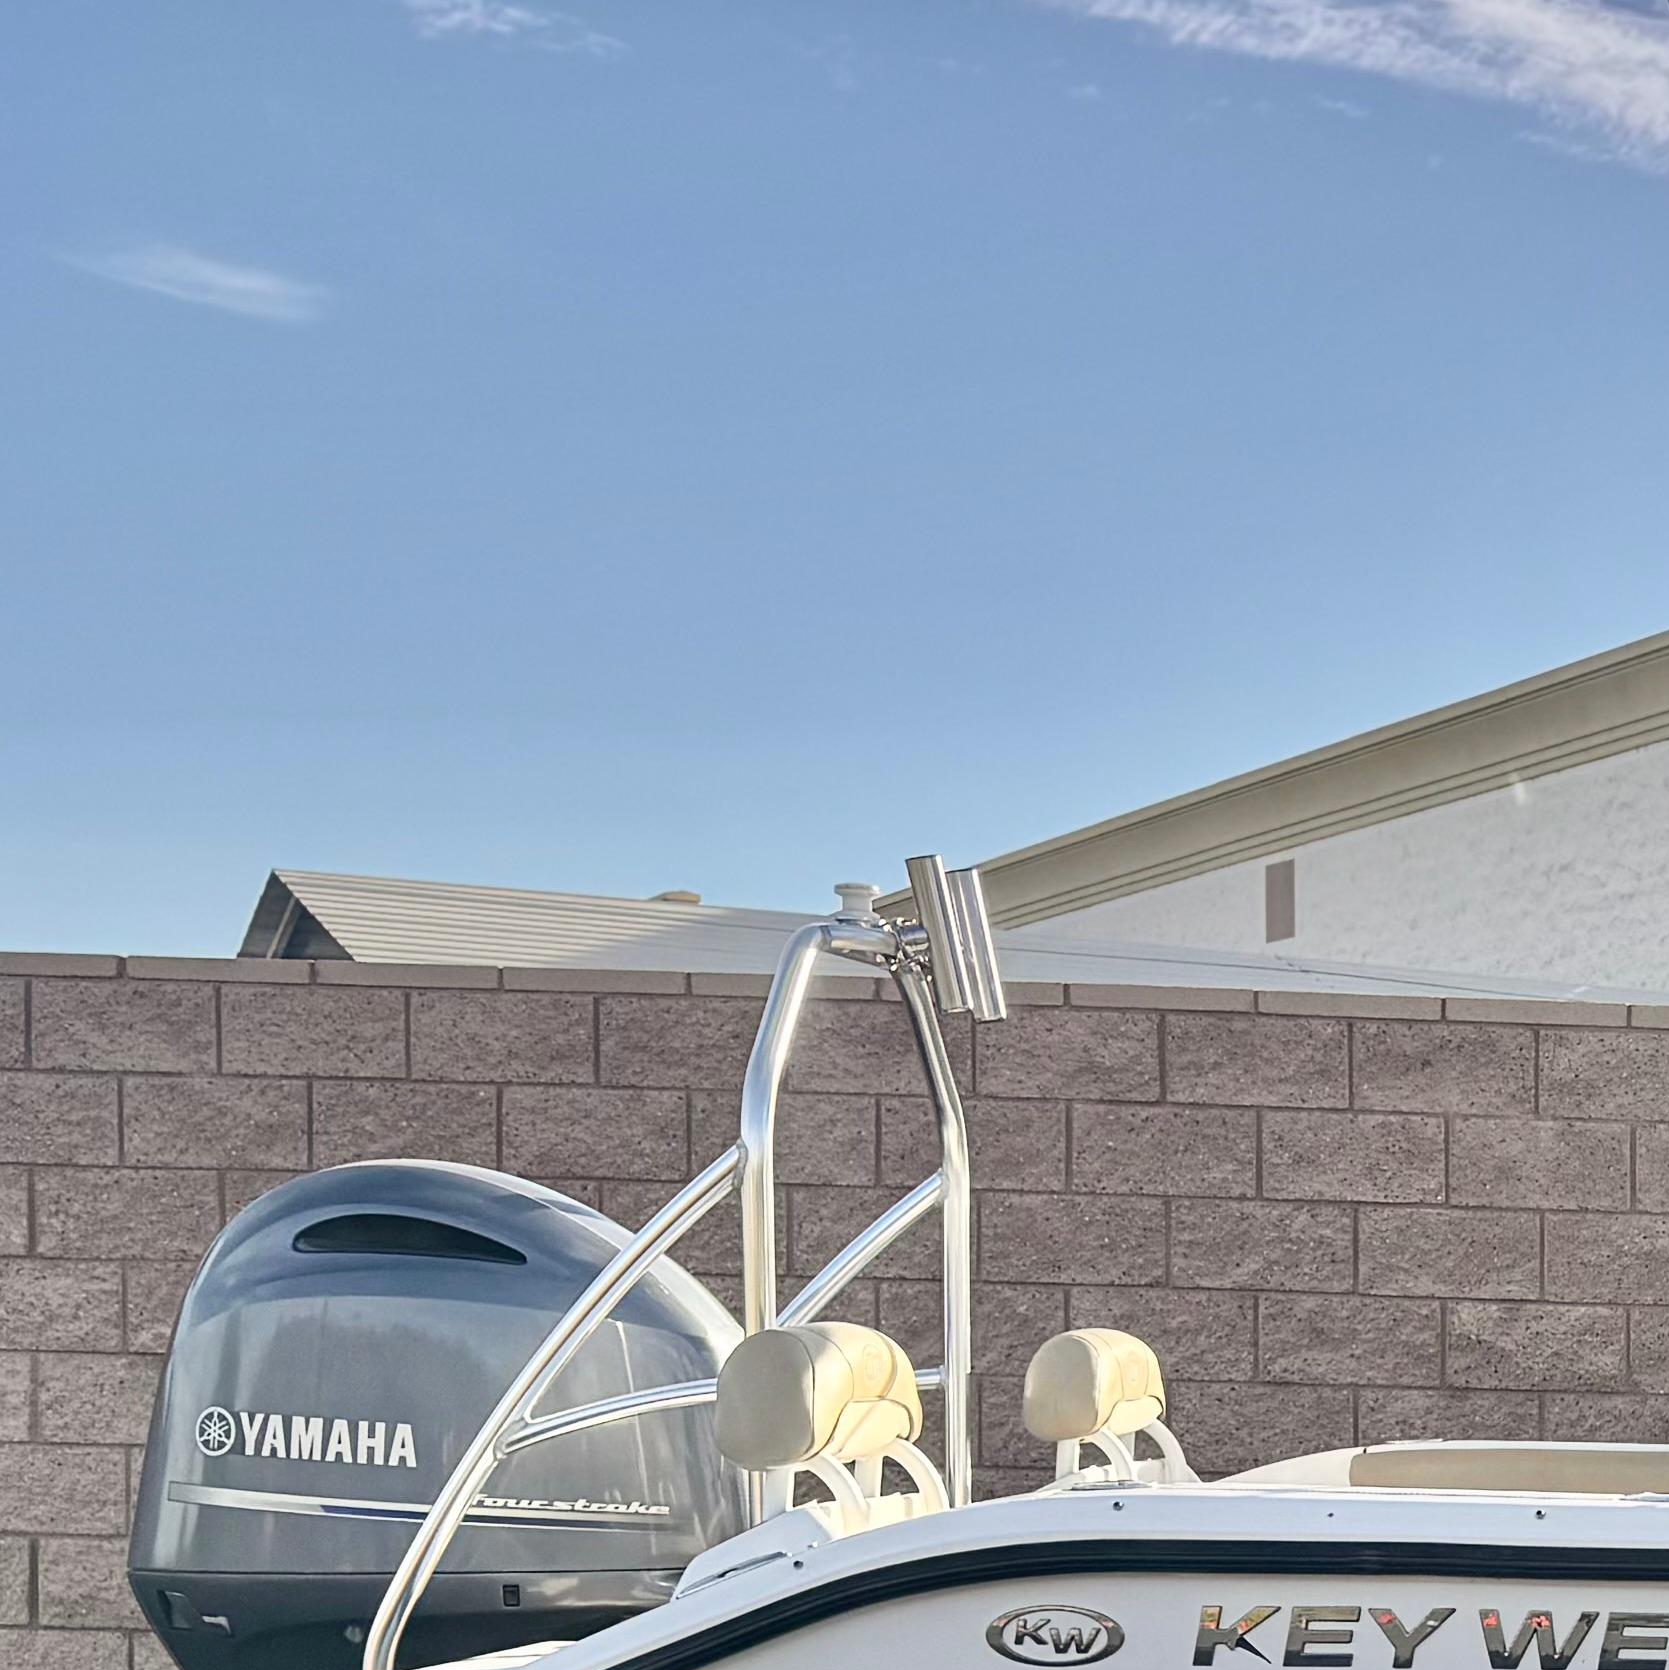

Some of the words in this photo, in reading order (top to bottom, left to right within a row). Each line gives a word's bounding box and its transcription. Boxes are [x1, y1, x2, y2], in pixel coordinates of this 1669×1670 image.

[239, 1411, 417, 1468] YAMAHA
[1013, 1617, 1101, 1655] KW
[1192, 1604, 1457, 1669] KEY
